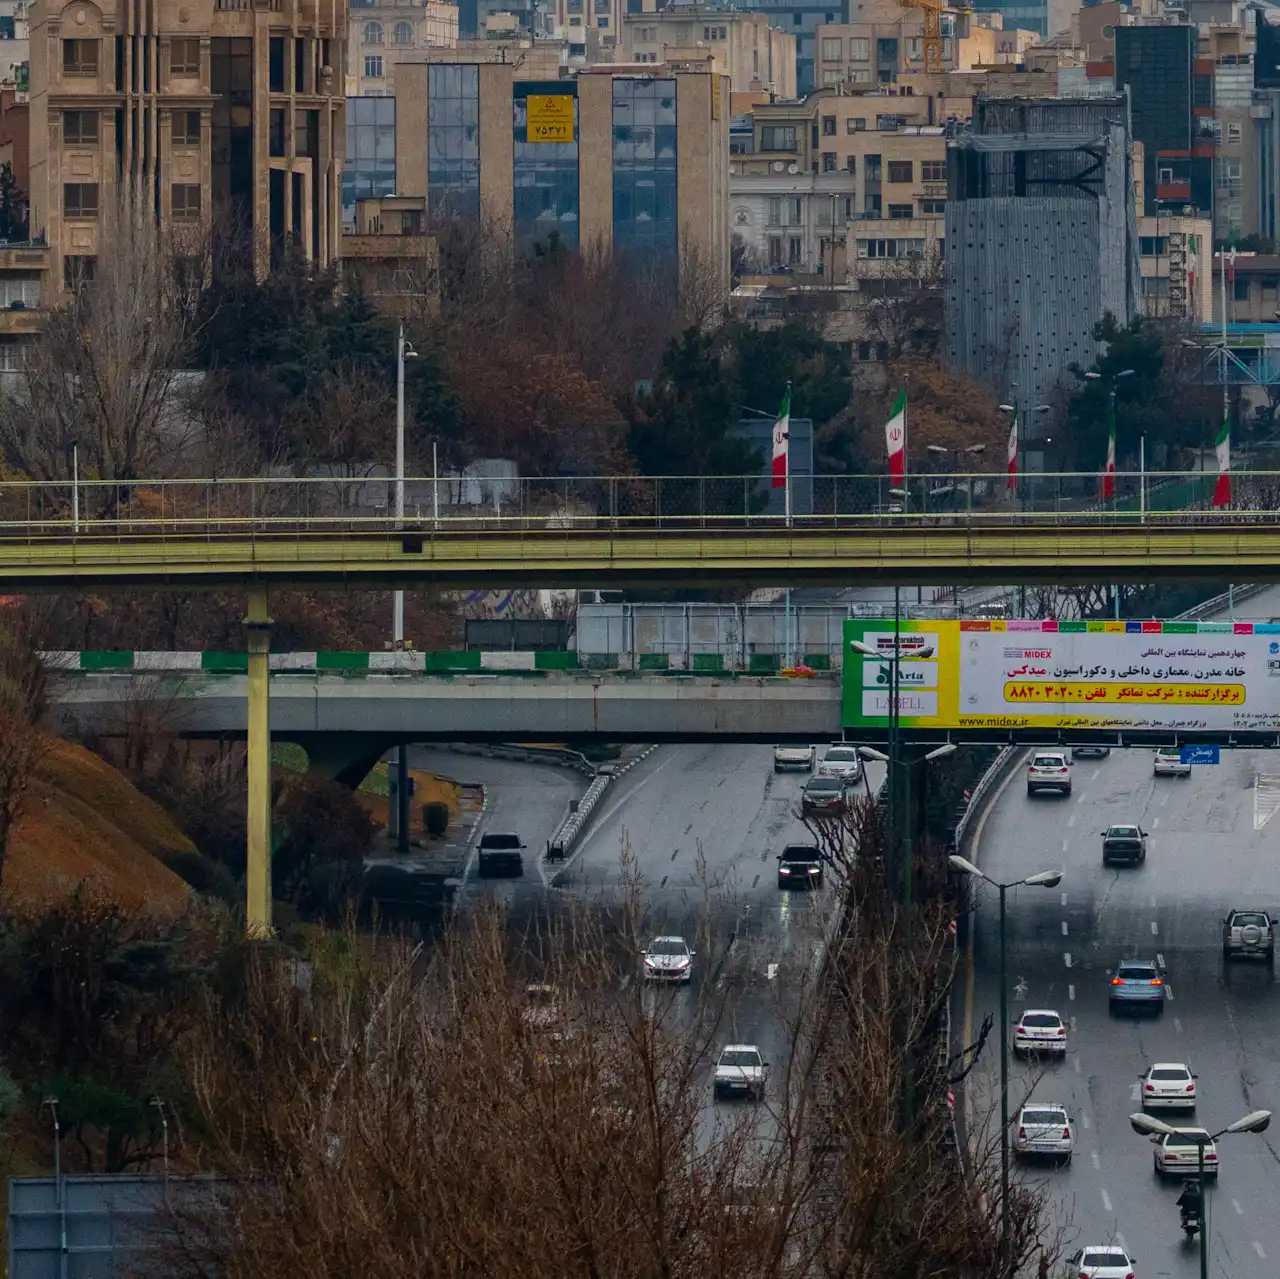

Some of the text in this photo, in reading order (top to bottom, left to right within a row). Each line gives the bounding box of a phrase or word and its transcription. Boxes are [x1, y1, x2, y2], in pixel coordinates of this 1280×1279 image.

[1140, 647, 1246, 659] چهاردهمین نمایشگاه بین المللی
[1053, 665, 1108, 677] دکوراسیون
[1110, 669, 1116, 678] و
[1118, 665, 1151, 677] داخلی
[1153, 665, 1190, 678] معماری
[1225, 665, 1246, 676] خانه
[1010, 686, 1040, 697] ۸۸۲۰
[1044, 686, 1073, 697] ۳۰۲۰
[1085, 686, 1107, 700] تلفن
[1146, 687, 1174, 700] شرکت
[959, 717, 1028, 727] www.midex.ir
